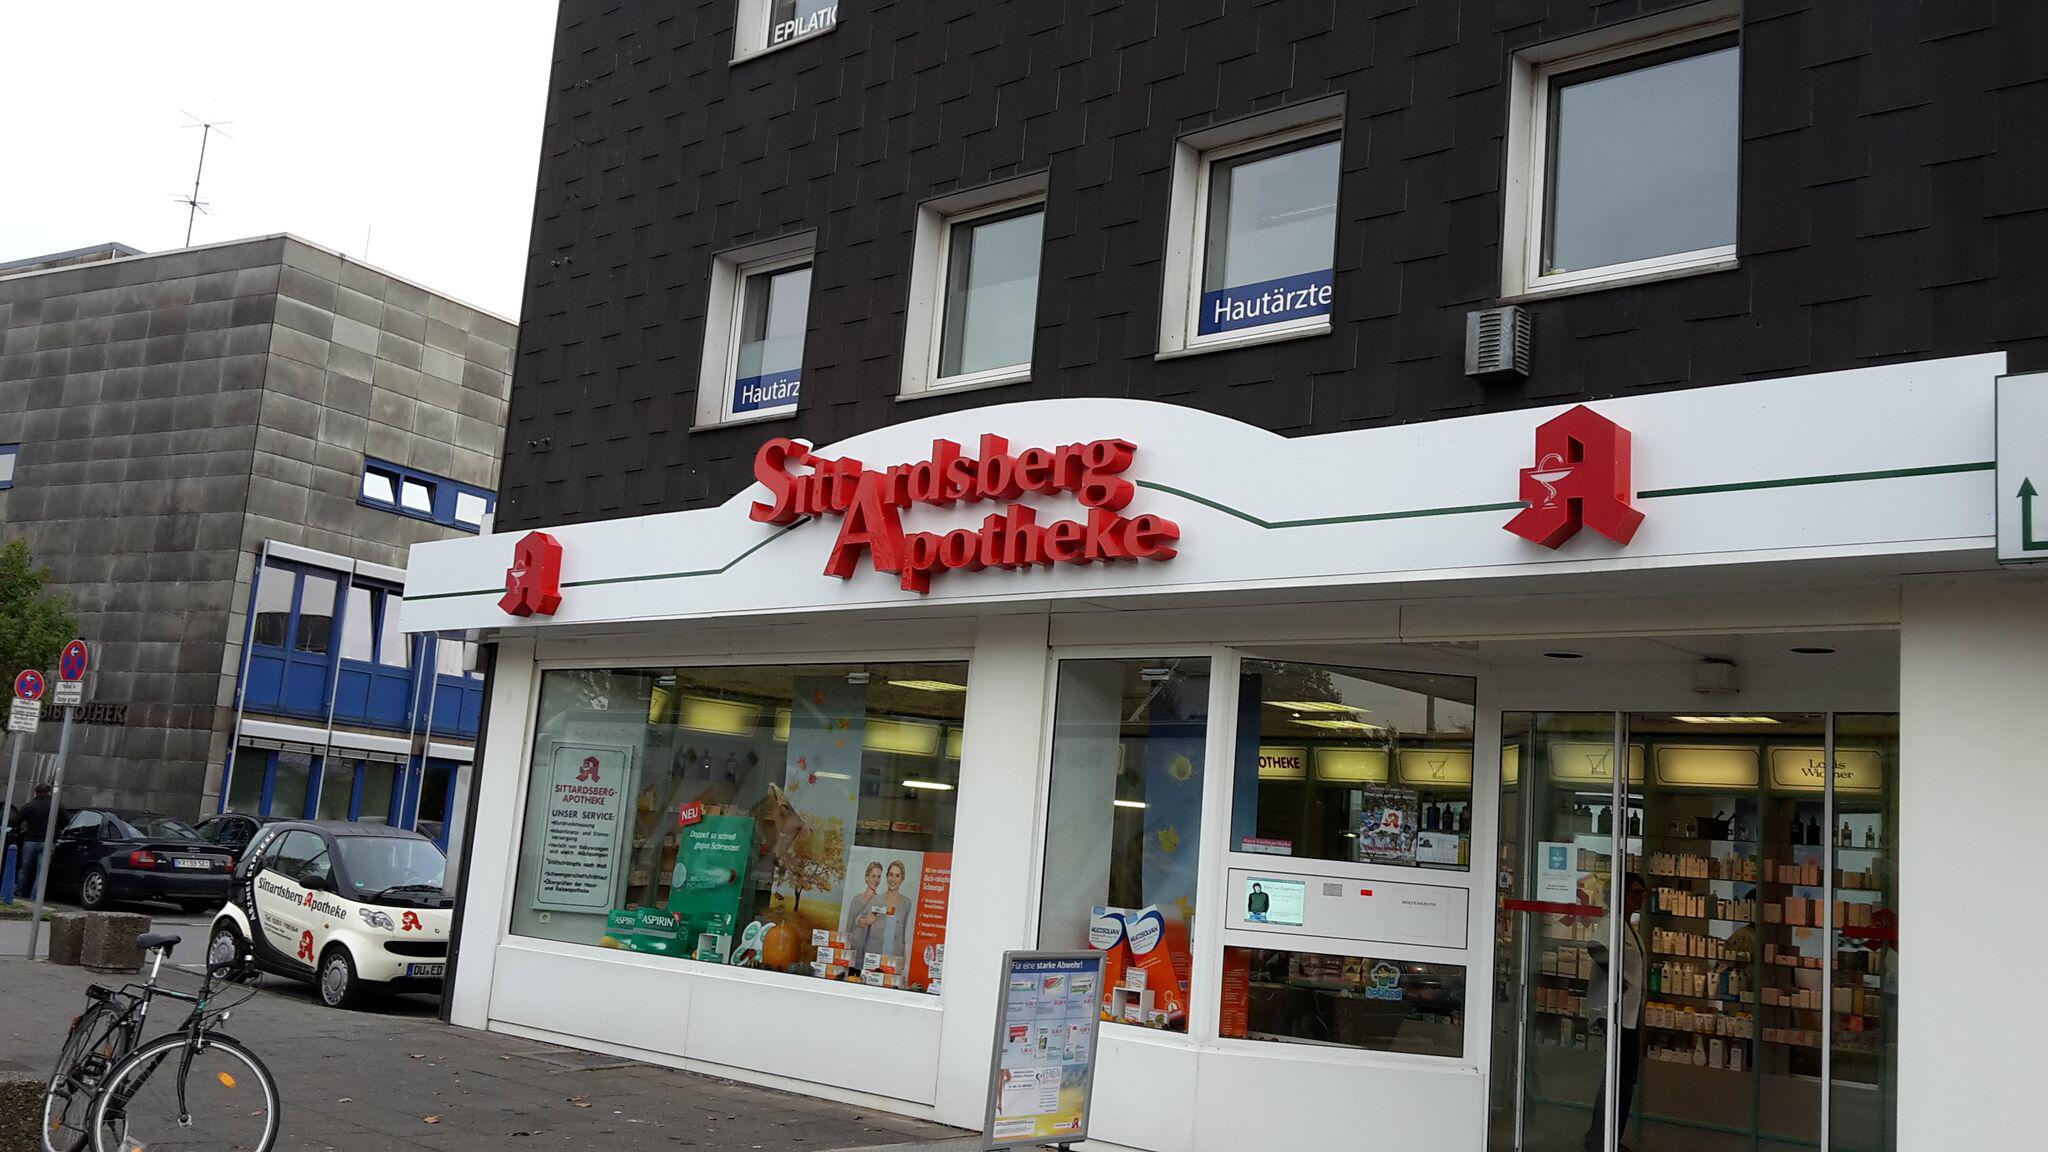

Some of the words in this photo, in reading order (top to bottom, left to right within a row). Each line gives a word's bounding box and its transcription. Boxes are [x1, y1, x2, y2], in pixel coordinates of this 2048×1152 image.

[1214, 284, 1333, 324] Hautärzte
[742, 379, 801, 405] Hautärz
[823, 470, 1180, 595] Apotheke
[41, 704, 129, 721] BIBOTHEK
[1808, 758, 1846, 769] Lois
[554, 784, 618, 797] SITTARDSBERG-
[562, 794, 606, 806] APOTHEKE
[551, 809, 578, 819] UNSER
[681, 807, 699, 820] NEU
[246, 831, 276, 877] EXPRESS
[258, 876, 304, 907] Sittardsberg
[303, 891, 348, 920] Apotheke
[641, 914, 676, 929] ASPIRIN
[413, 965, 426, 977] DU
[429, 965, 443, 977] ED
[1011, 960, 1022, 970] Für
[1022, 962, 1035, 970] eine
[1036, 961, 1056, 969] starke
[1057, 960, 1083, 969] Abwehr!
[1366, 987, 1402, 999] notinsel
